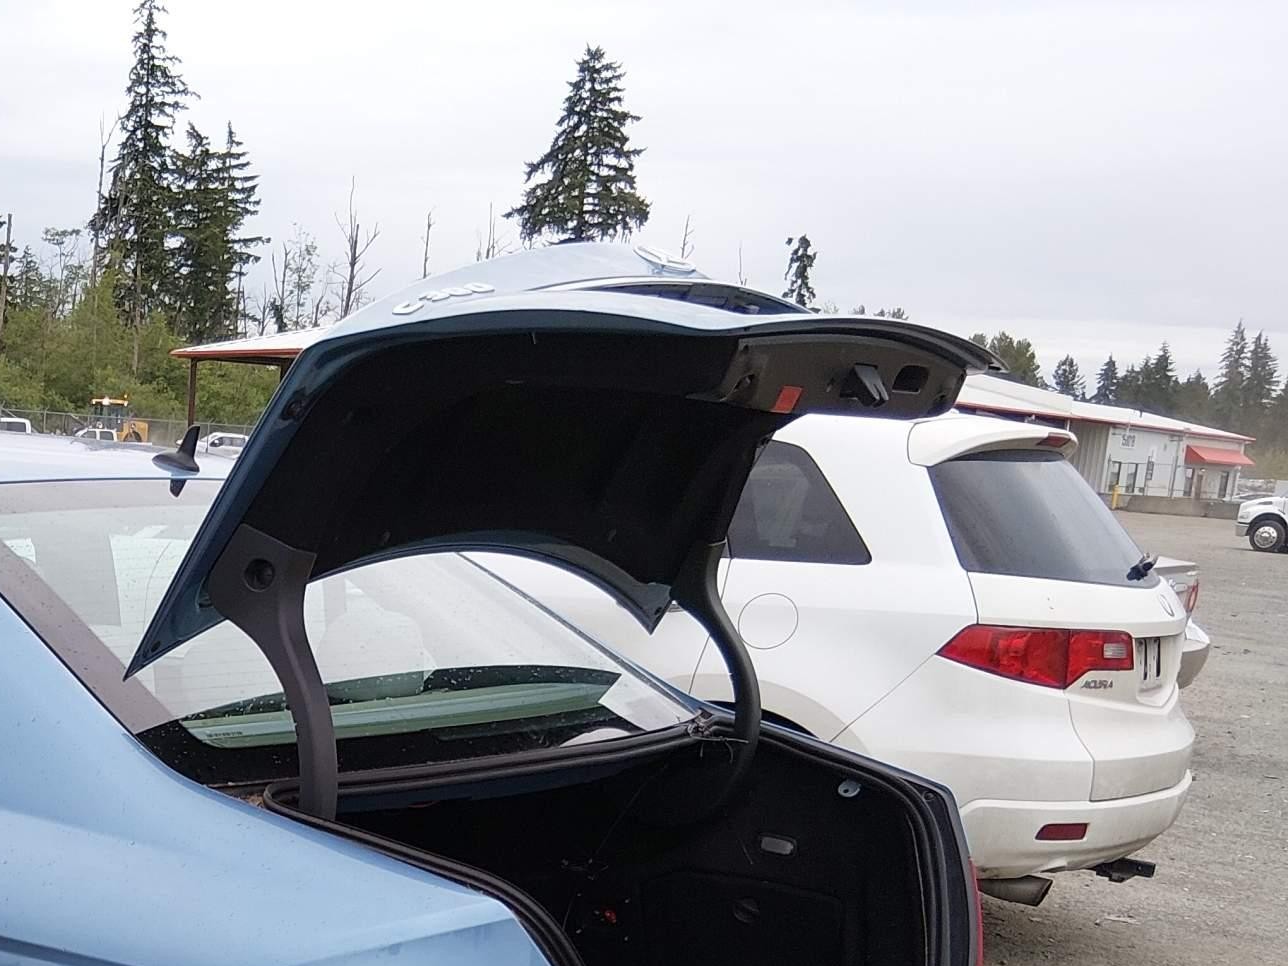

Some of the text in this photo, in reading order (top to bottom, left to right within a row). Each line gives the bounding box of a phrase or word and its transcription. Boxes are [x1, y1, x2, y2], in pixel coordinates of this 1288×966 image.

[392, 283, 496, 316] C 300
[1081, 679, 1114, 689] ACURA
